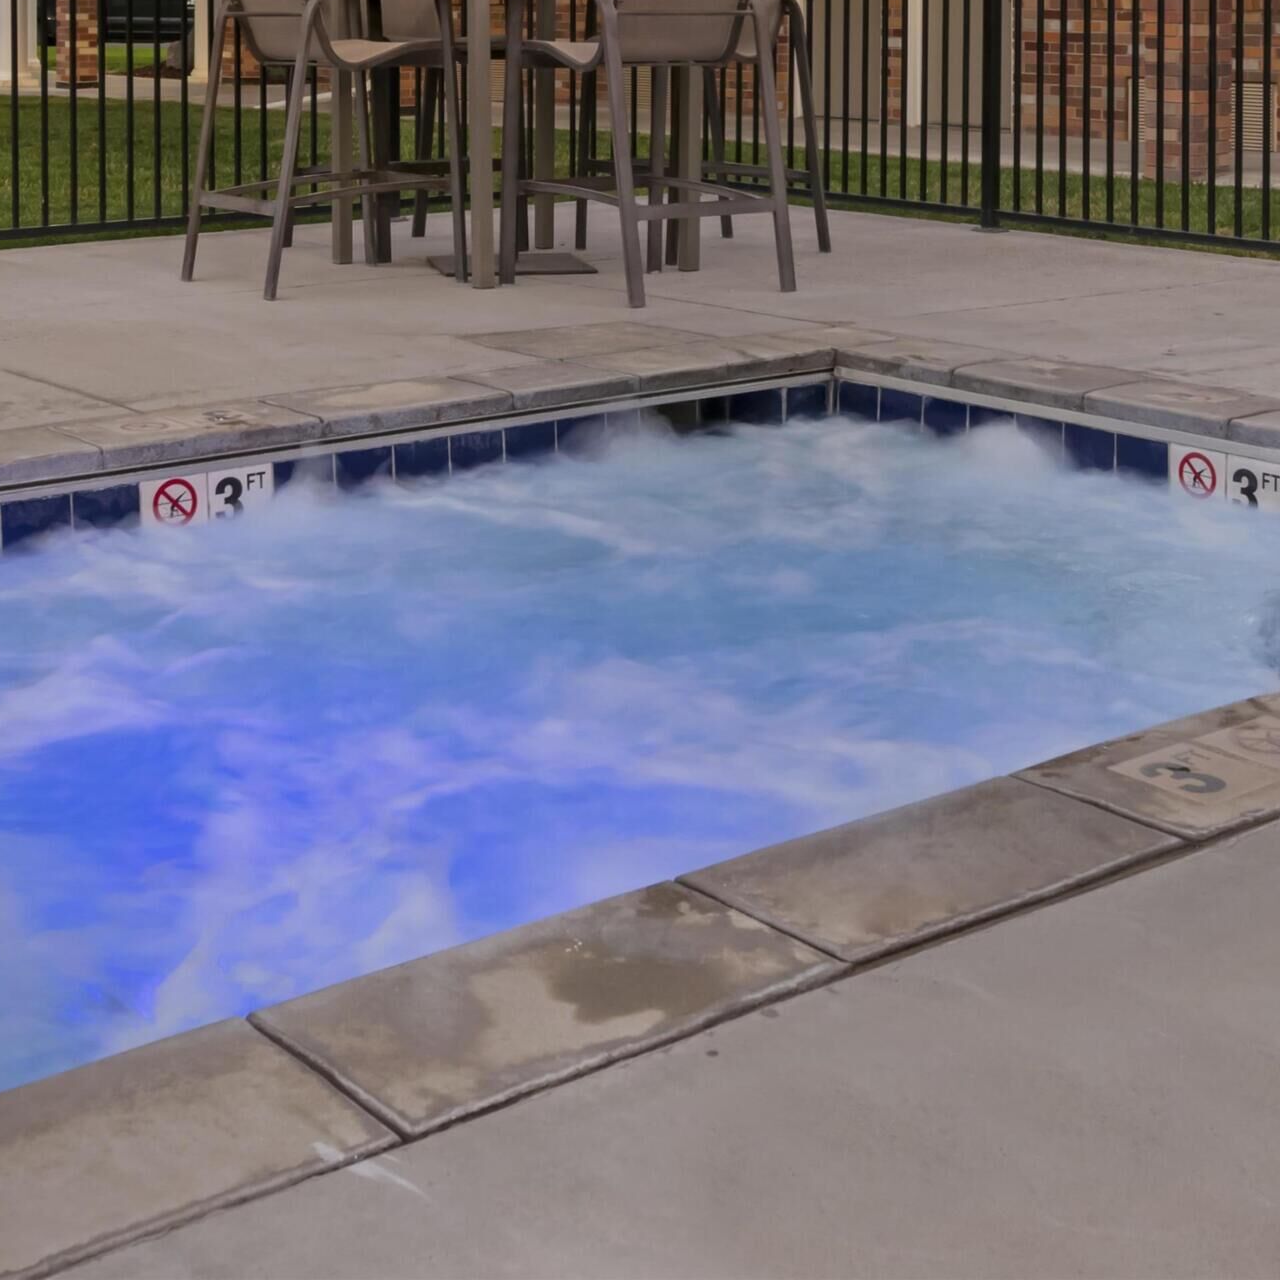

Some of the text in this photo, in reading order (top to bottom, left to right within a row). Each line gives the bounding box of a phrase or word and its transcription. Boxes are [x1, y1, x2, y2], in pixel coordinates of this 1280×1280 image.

[215, 471, 266, 519] 3 FT
[1232, 468, 1280, 508] 3 FT
